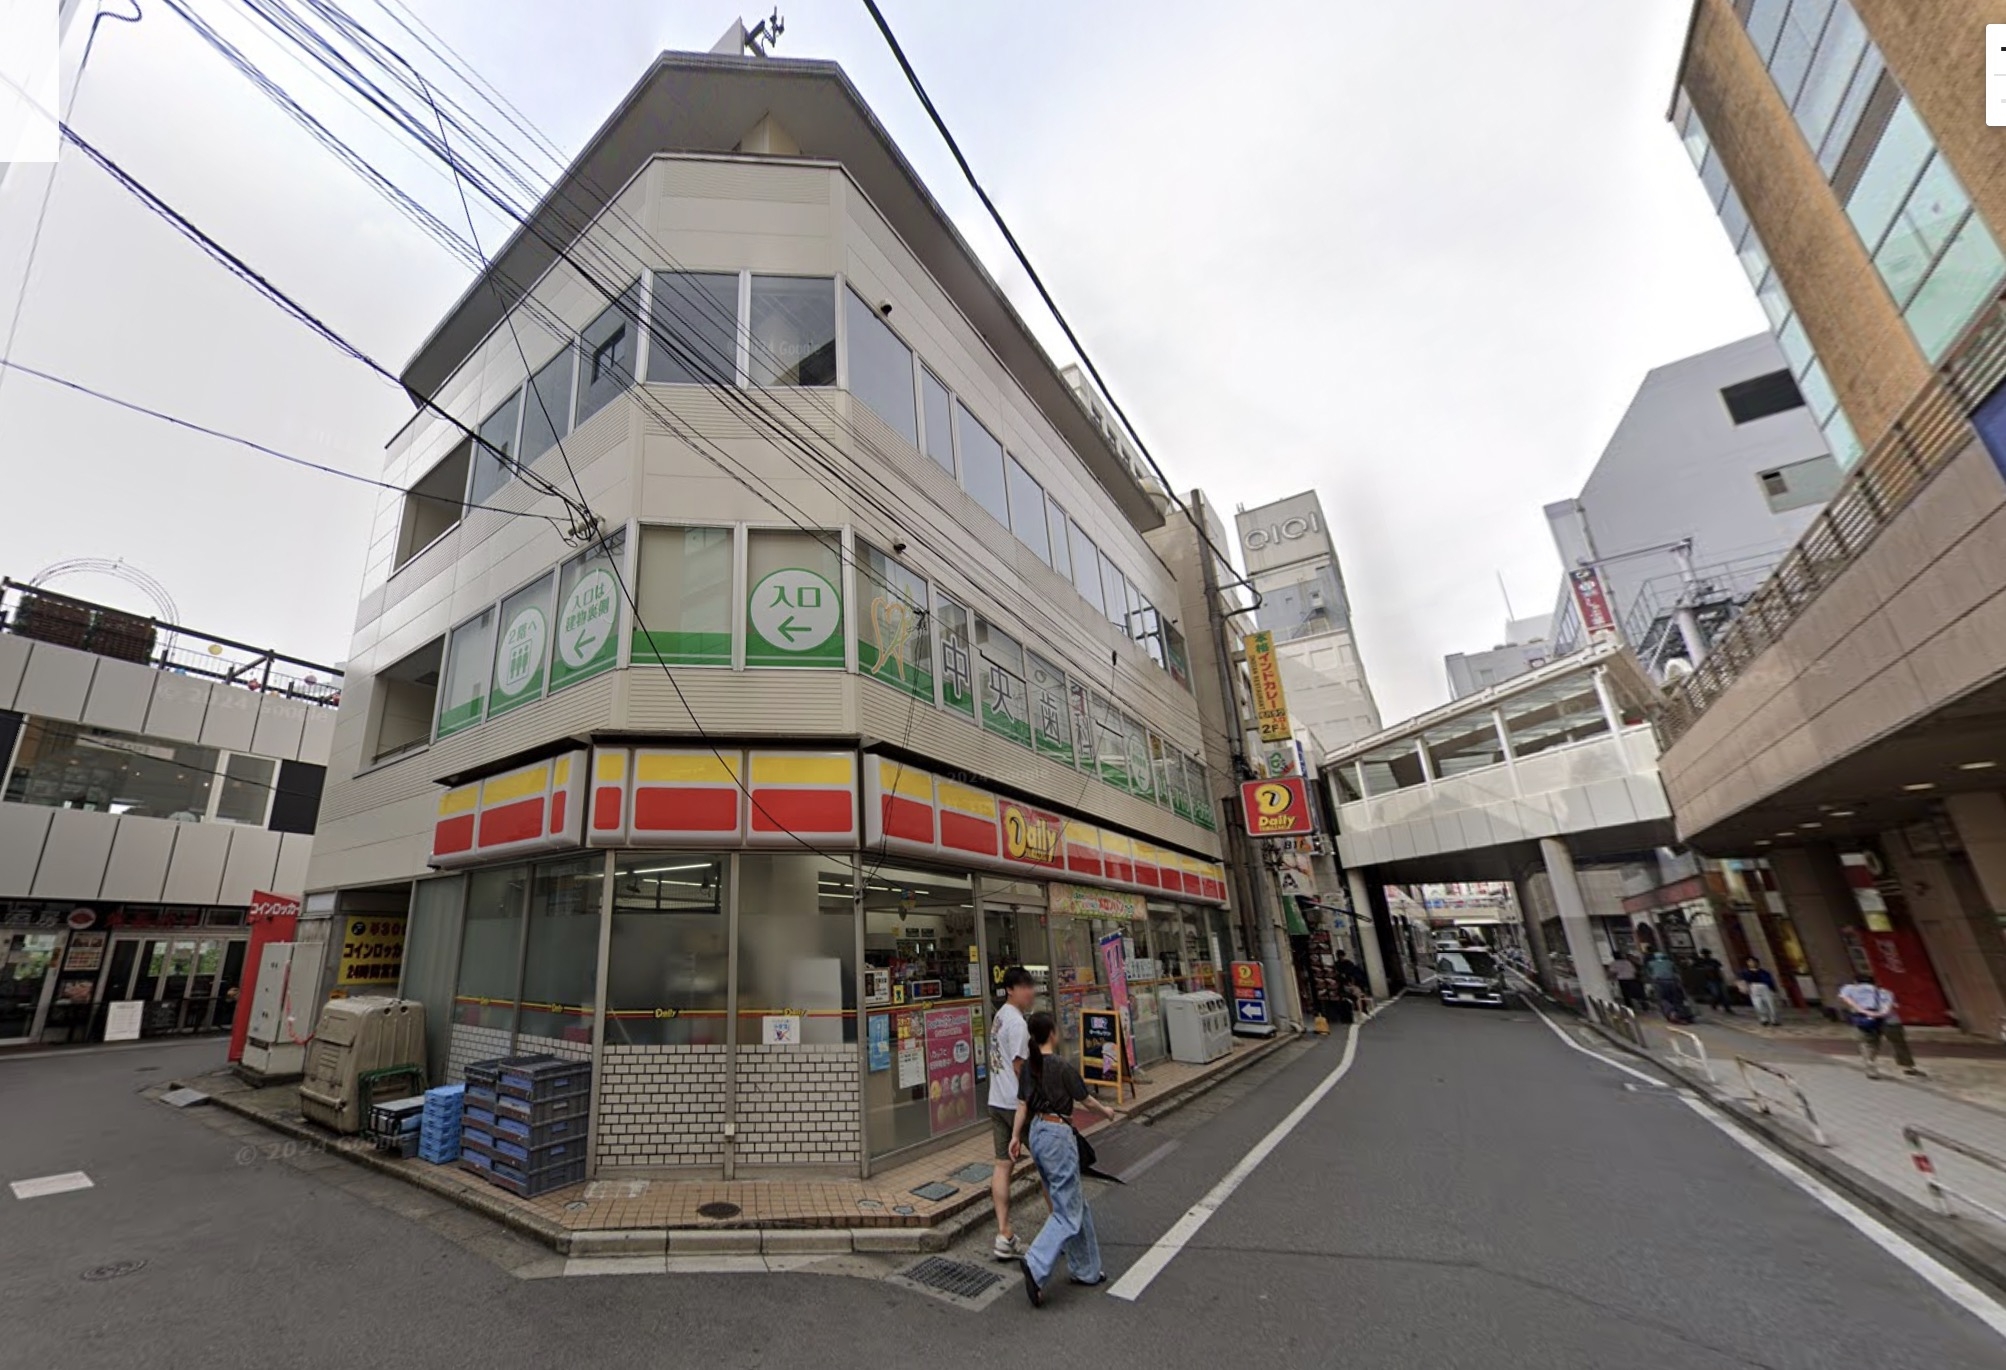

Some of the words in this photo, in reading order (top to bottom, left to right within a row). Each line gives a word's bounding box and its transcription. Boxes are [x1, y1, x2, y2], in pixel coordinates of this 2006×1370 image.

[572, 582, 605, 613] 入口は
[769, 585, 821, 609] 入口
[565, 596, 610, 633] 建物裏側
[507, 619, 538, 645] 2階へ
[1261, 724, 1279, 734] 2F
[1005, 805, 1058, 863] Daily
[1258, 814, 1296, 829] Daily
[655, 1008, 678, 1018] Daily
